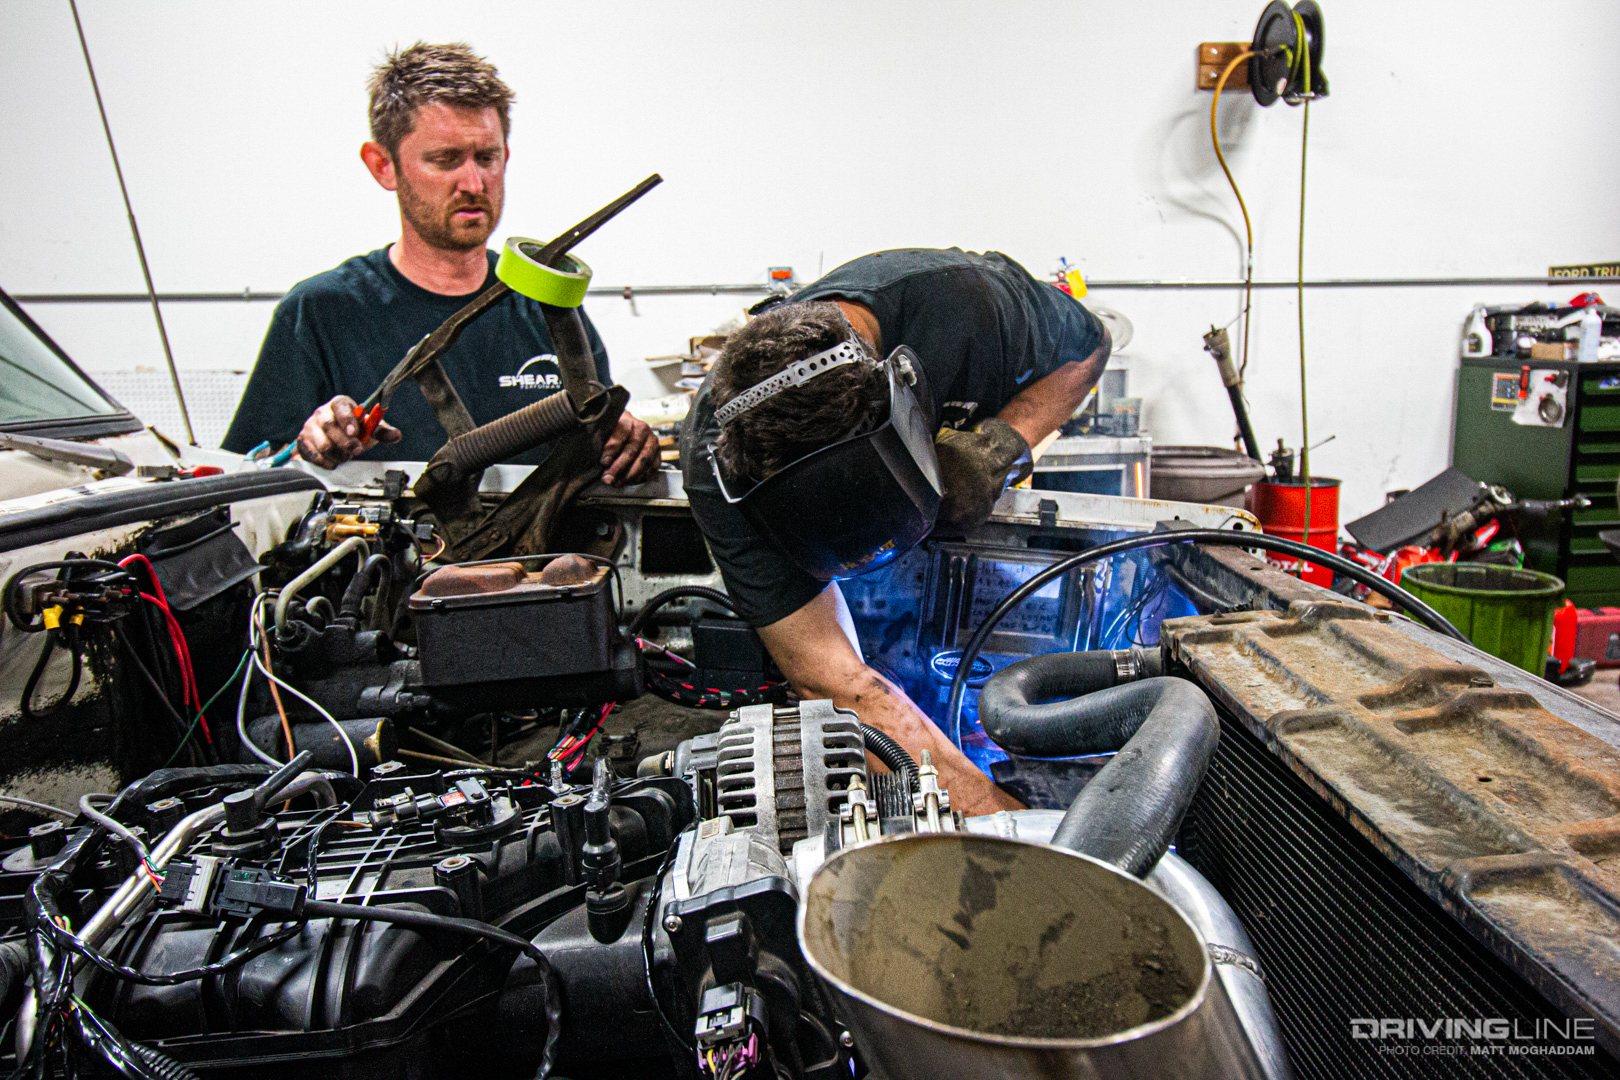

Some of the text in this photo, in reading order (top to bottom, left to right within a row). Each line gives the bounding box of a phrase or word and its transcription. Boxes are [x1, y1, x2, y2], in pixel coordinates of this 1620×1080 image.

[1554, 268, 1590, 277] FORD
[498, 374, 559, 387] SHEAR
[1267, 557, 1314, 573] OTAL
